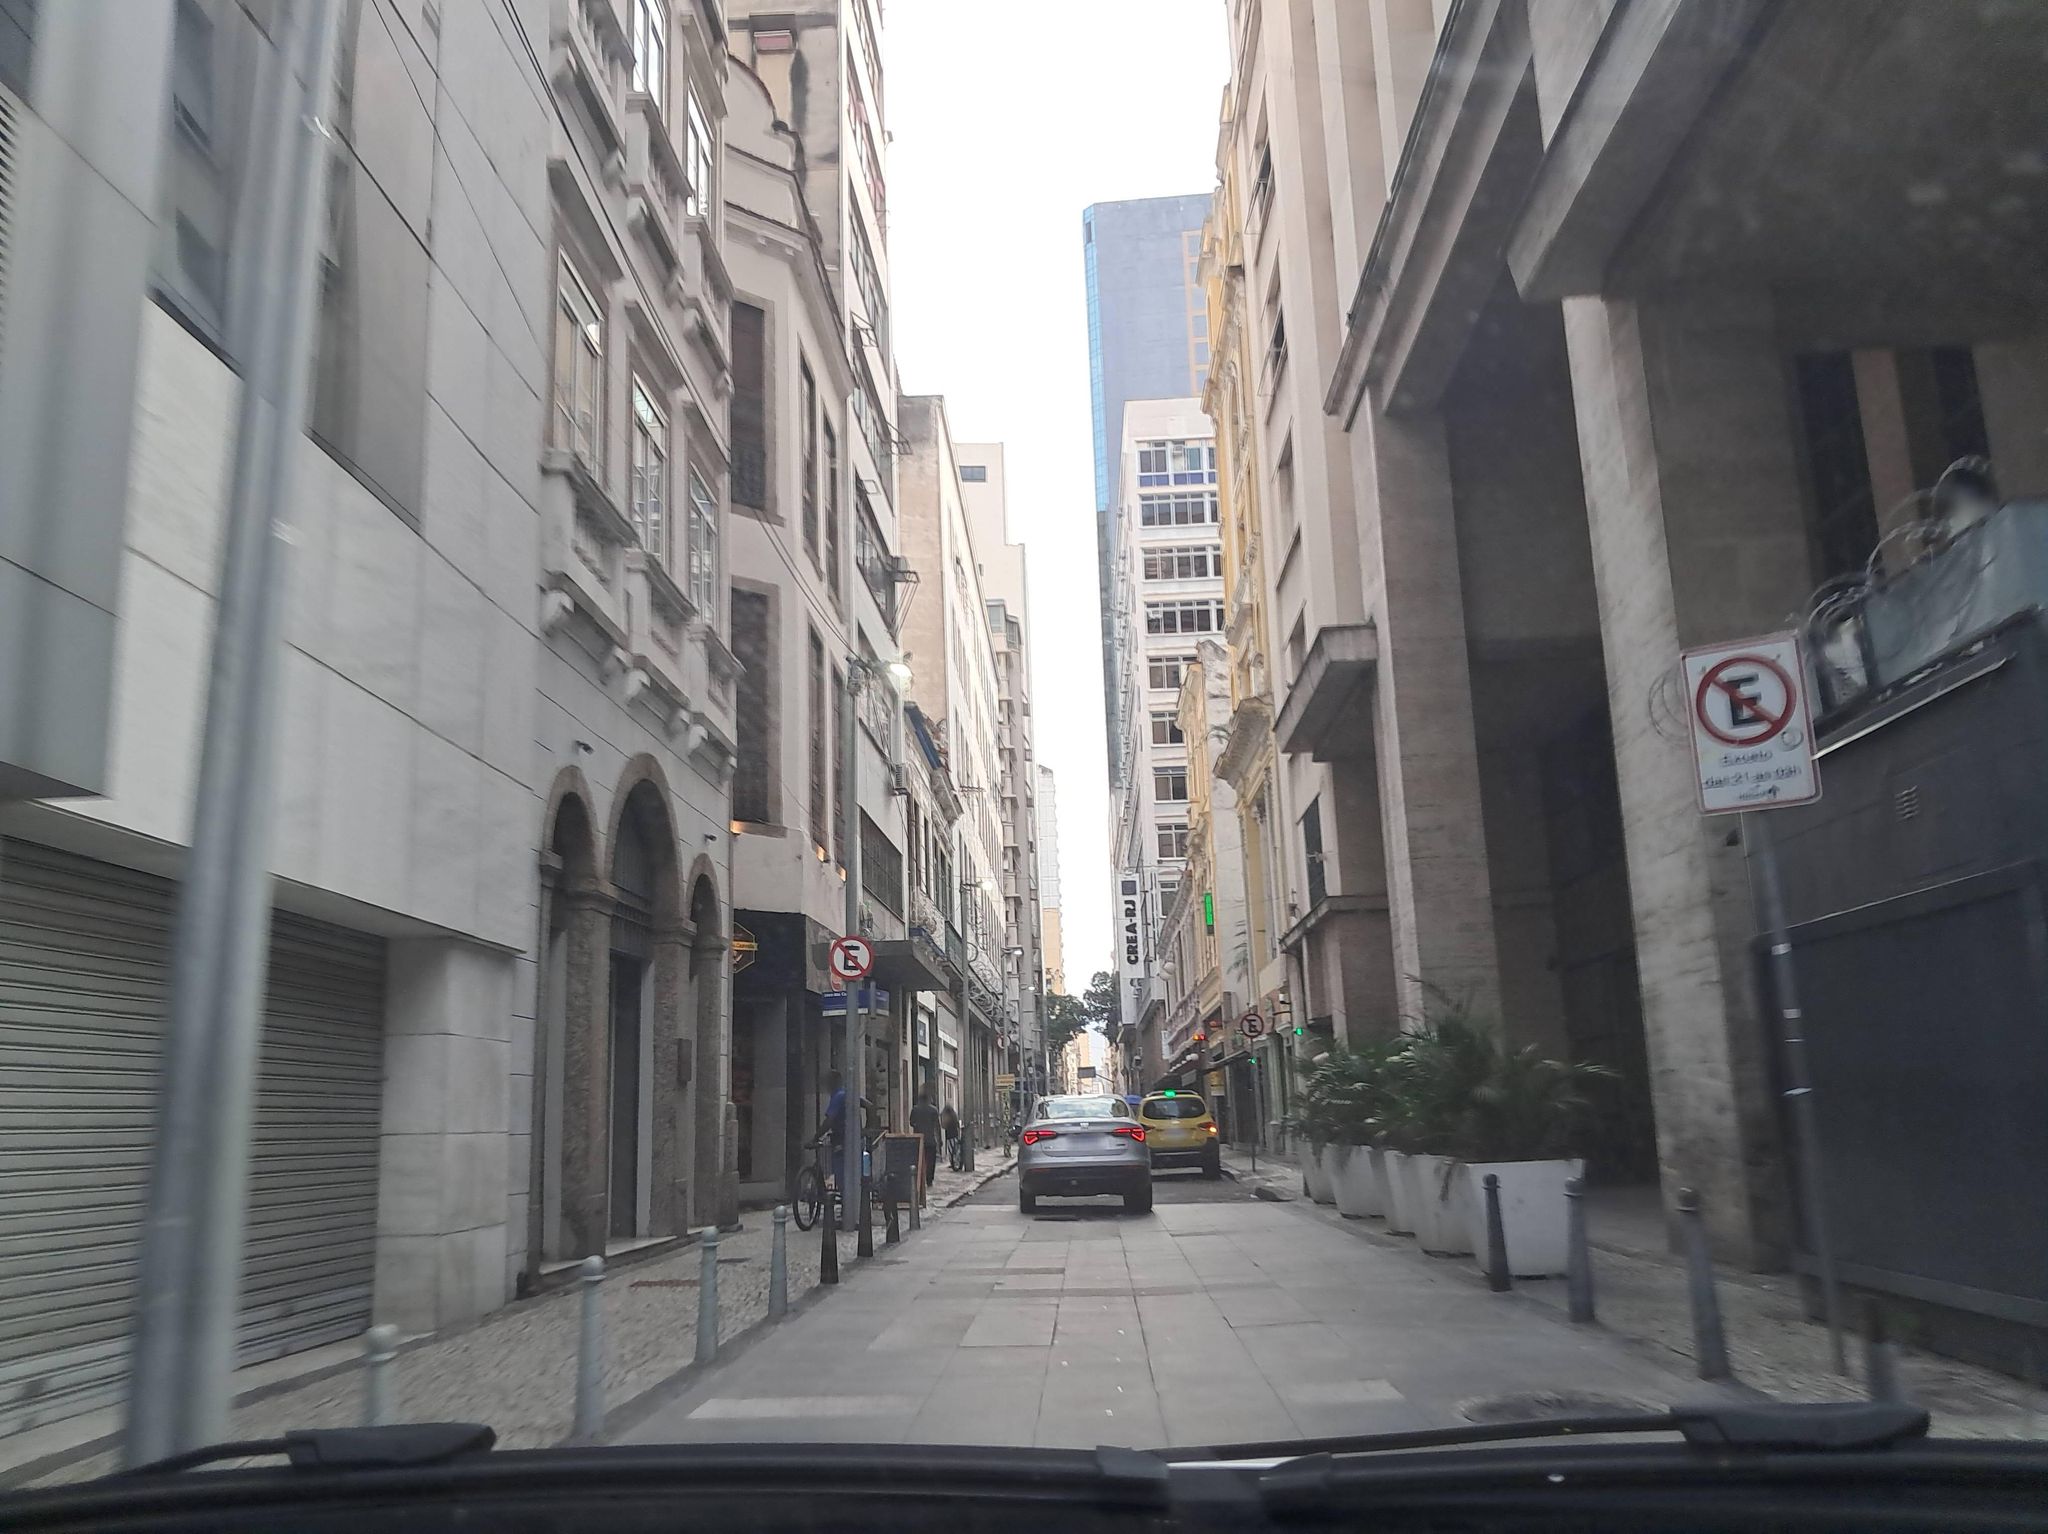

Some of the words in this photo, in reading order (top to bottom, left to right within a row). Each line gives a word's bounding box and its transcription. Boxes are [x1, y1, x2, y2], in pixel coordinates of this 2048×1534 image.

[1725, 671, 1763, 727] E
[1124, 899, 1139, 965] CREA-RJ
[844, 945, 860, 970] E
[1249, 1019, 1257, 1033] E
